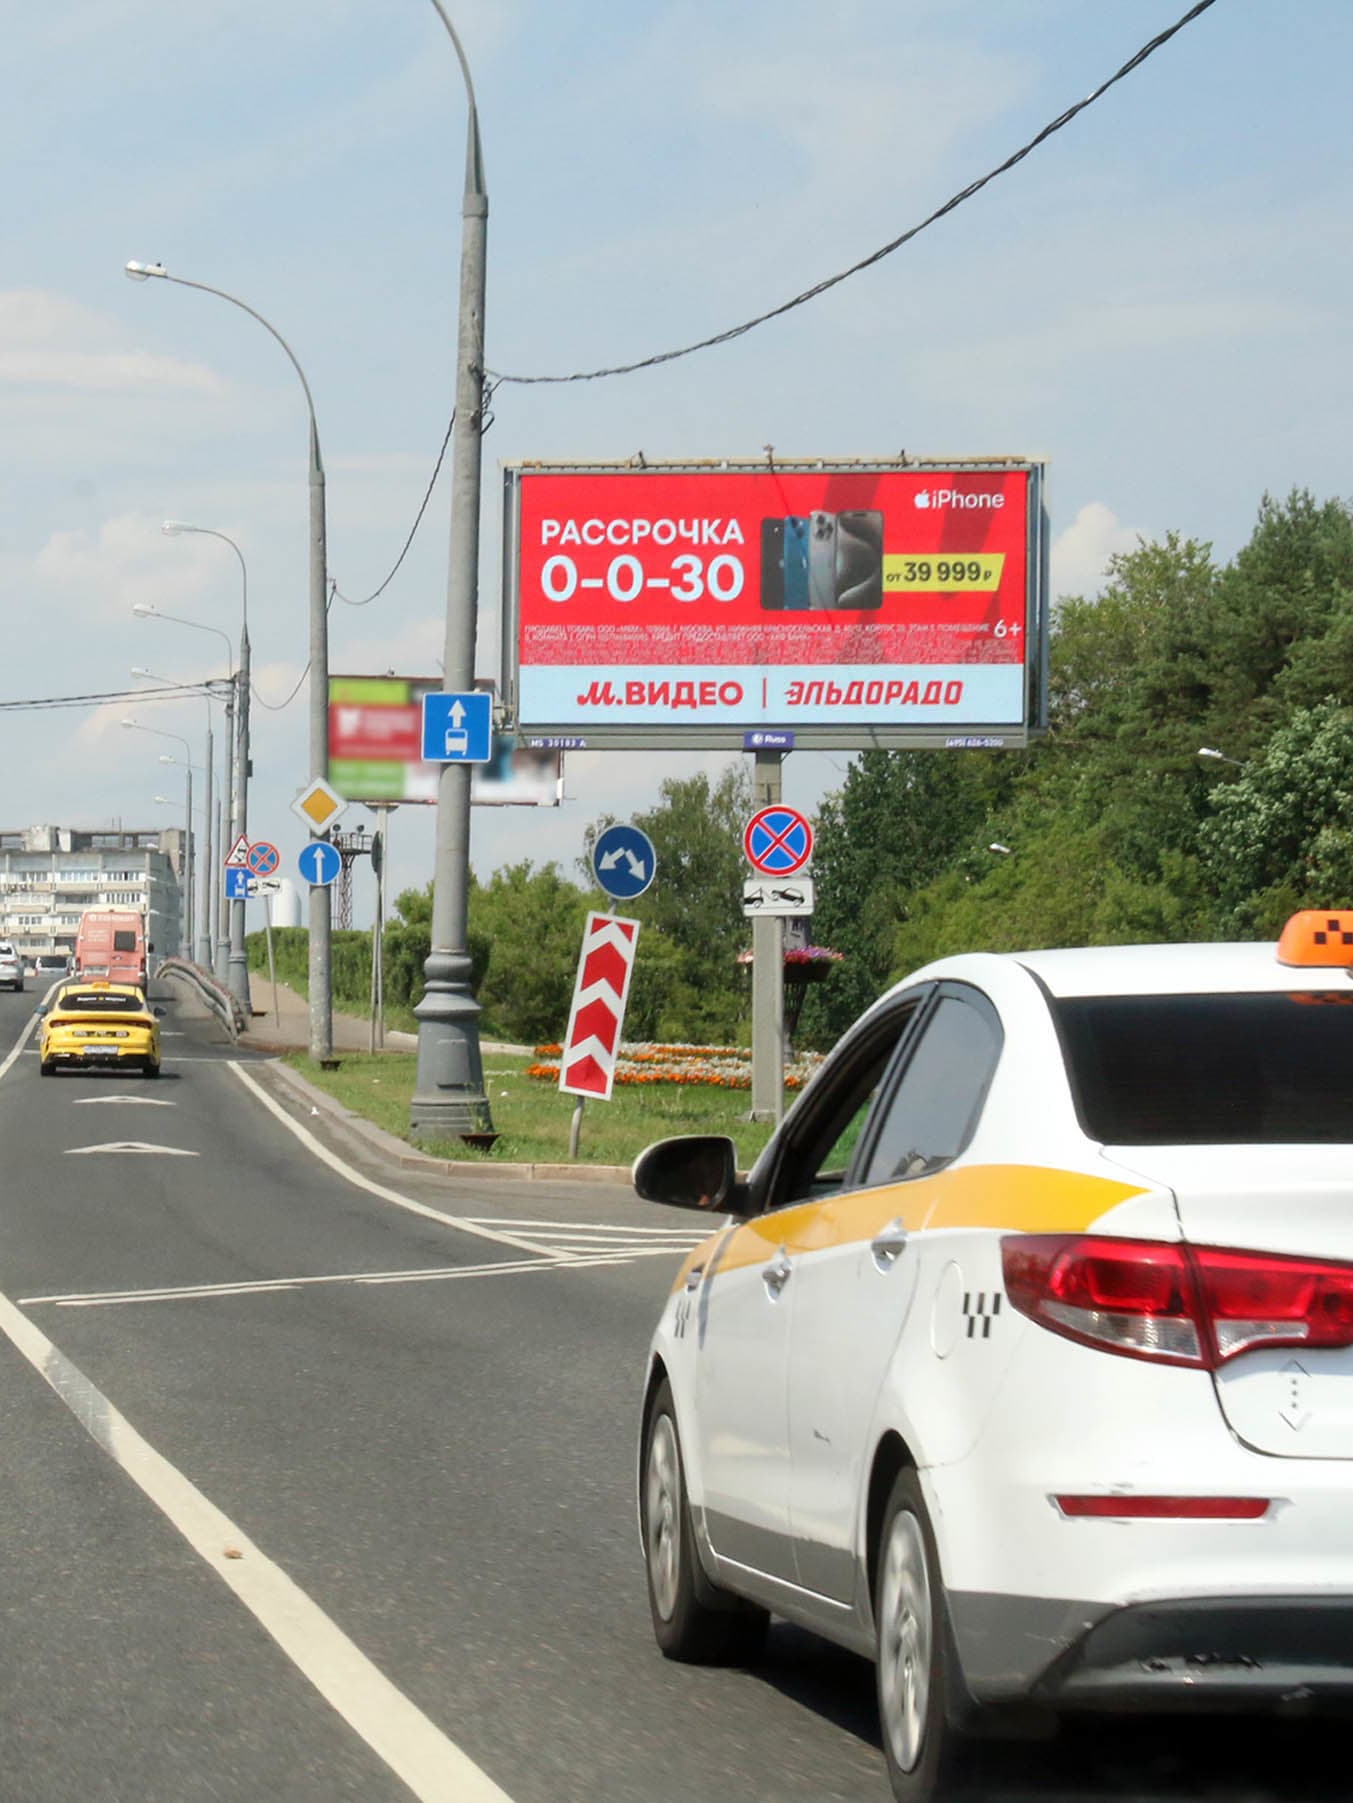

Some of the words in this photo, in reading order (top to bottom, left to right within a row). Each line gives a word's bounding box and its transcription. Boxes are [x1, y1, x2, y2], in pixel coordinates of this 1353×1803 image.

[932, 489, 1005, 509] iPhone
[541, 518, 745, 545] РАССРОЧКА
[541, 554, 745, 602] 0-0-30
[904, 562, 932, 582] 39
[993, 619, 1022, 638] 6+
[785, 680, 964, 706] ЭЛЬДОРАДО
